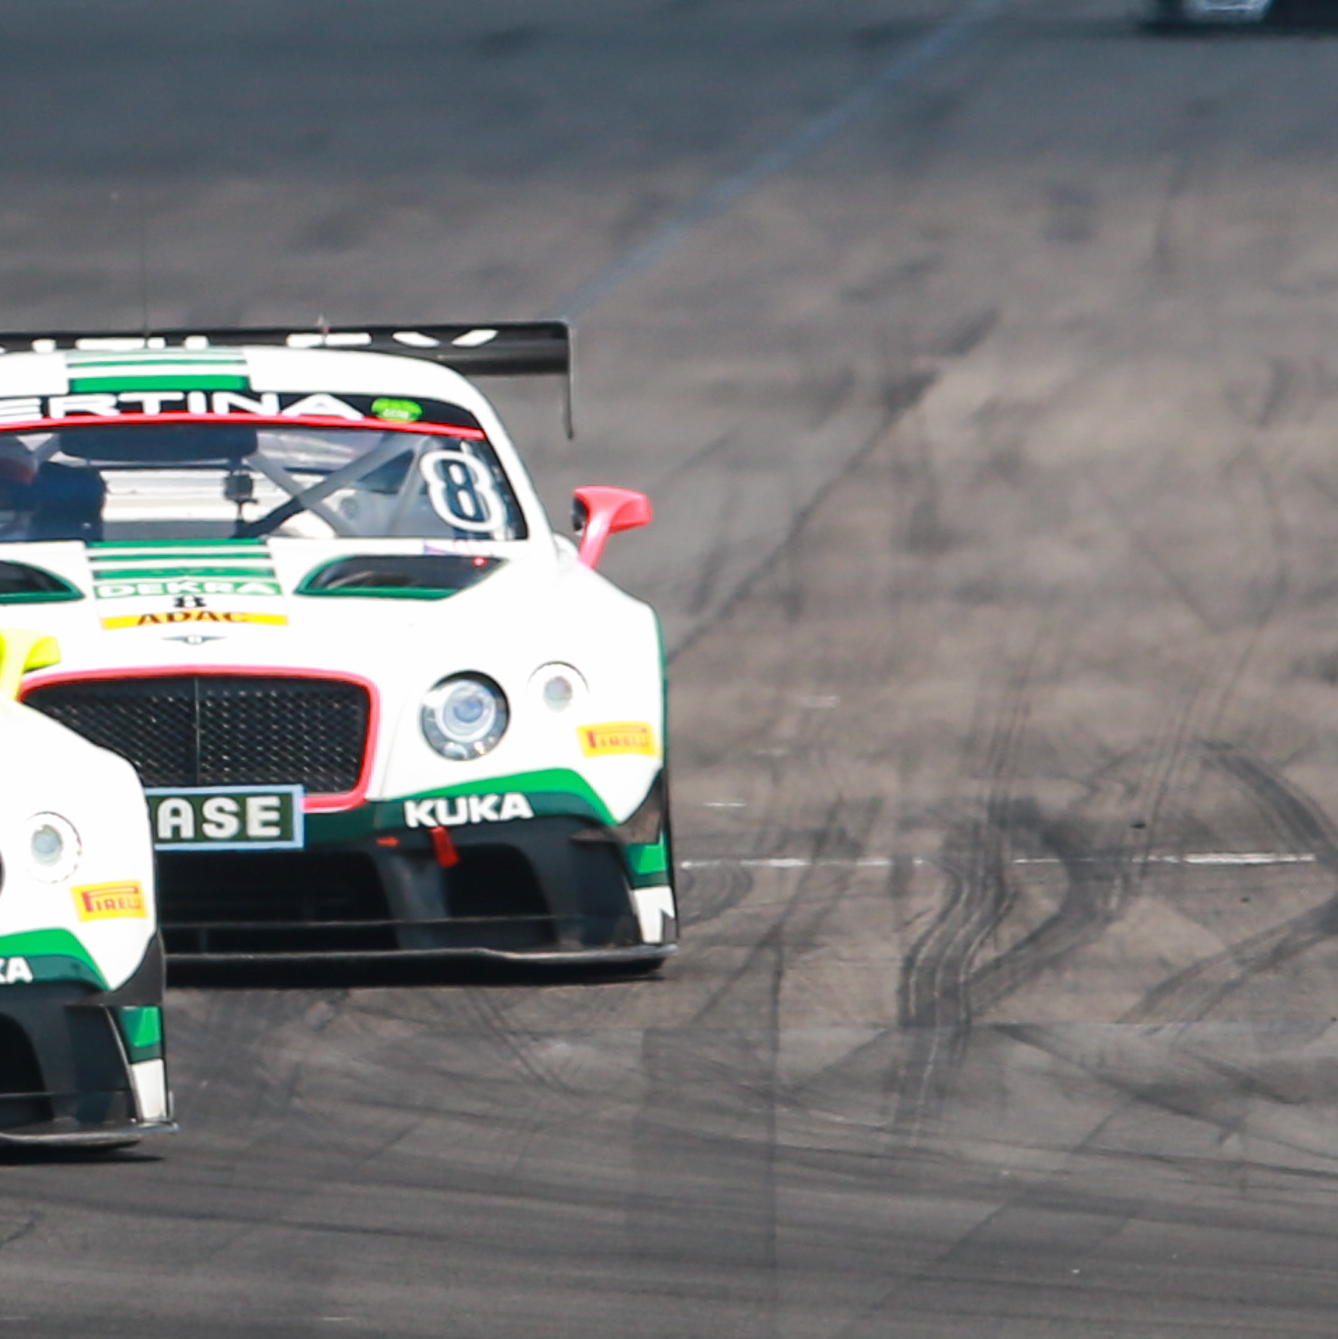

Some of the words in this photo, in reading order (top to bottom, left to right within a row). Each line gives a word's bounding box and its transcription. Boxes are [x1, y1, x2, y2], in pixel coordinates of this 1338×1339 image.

[419, 449, 506, 532] 8
[97, 582, 277, 598] DEKRA
[137, 611, 249, 626] ADAC
[157, 795, 281, 839] ASE
[404, 792, 534, 828] KUKA
